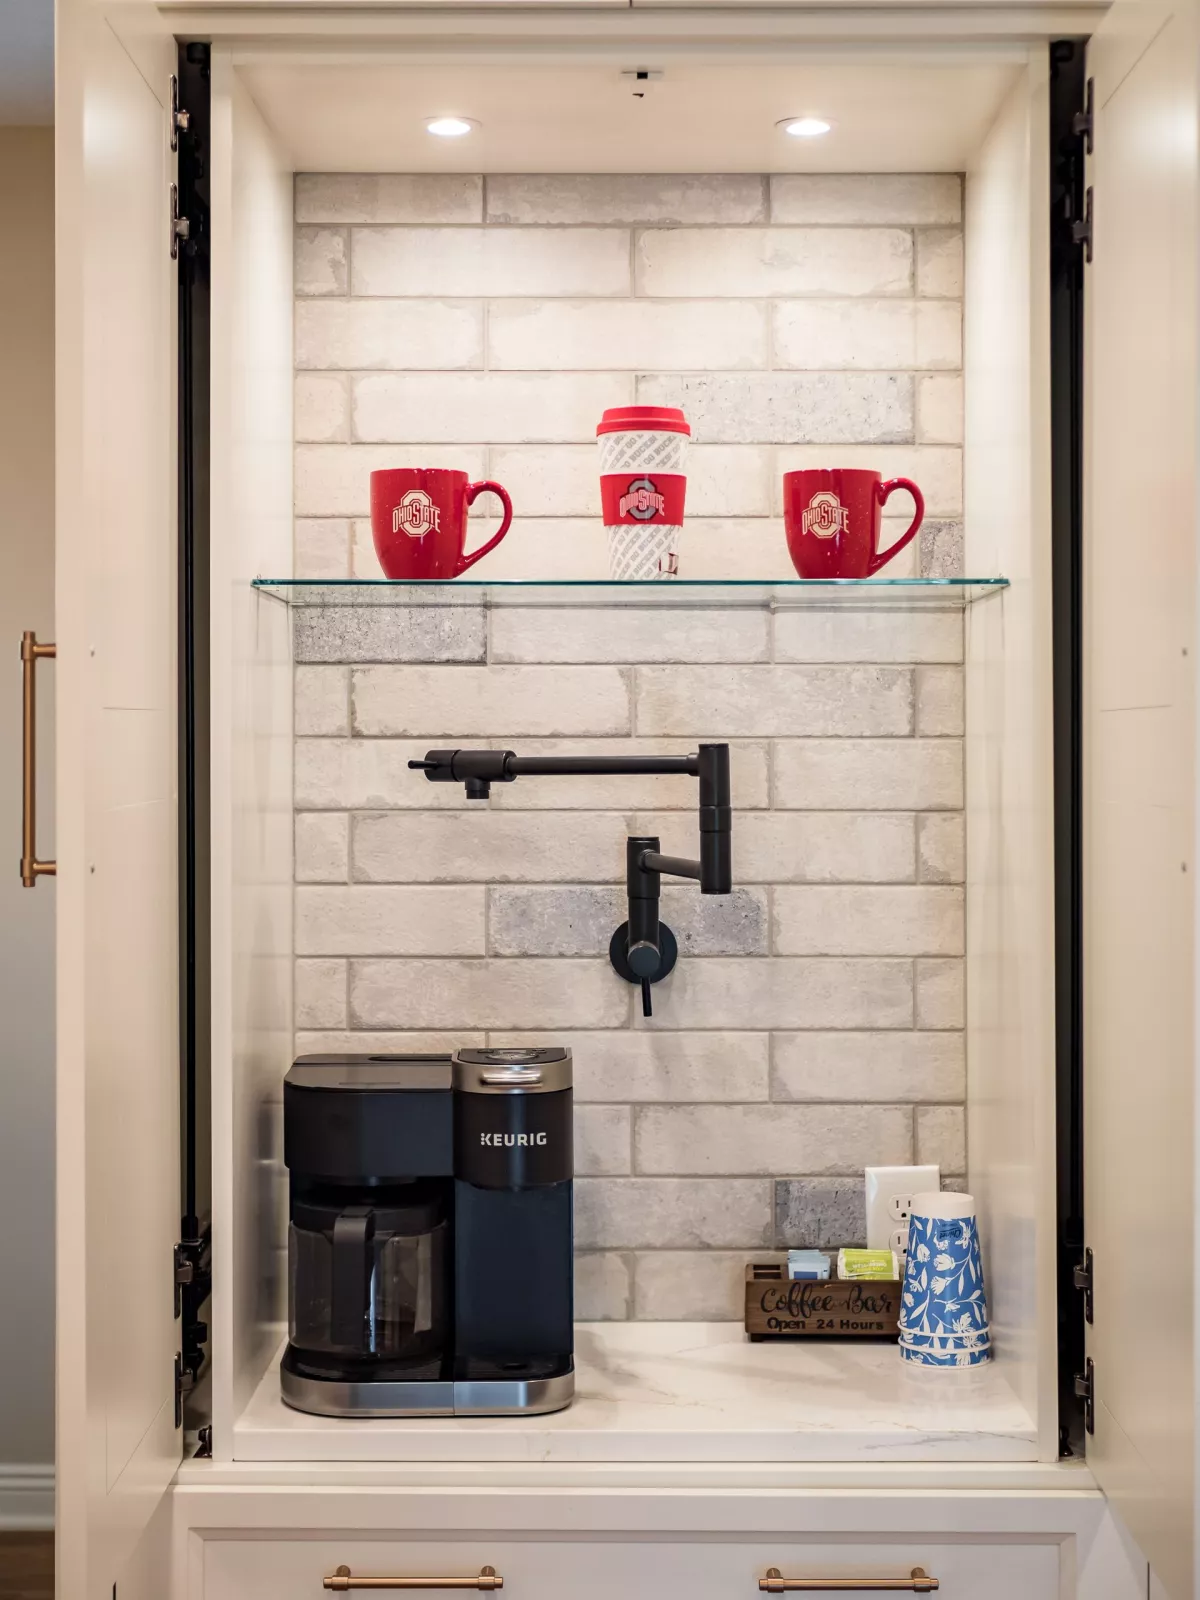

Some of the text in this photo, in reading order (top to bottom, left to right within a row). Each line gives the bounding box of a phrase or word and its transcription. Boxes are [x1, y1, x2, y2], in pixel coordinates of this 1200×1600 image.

[393, 502, 440, 533] OHIO STATE
[802, 504, 849, 535] OHIO STATE
[480, 1132, 547, 1147] KEURIG
[760, 1282, 892, 1319] Coffee Bar
[767, 1317, 884, 1332] Open 24 Hours
